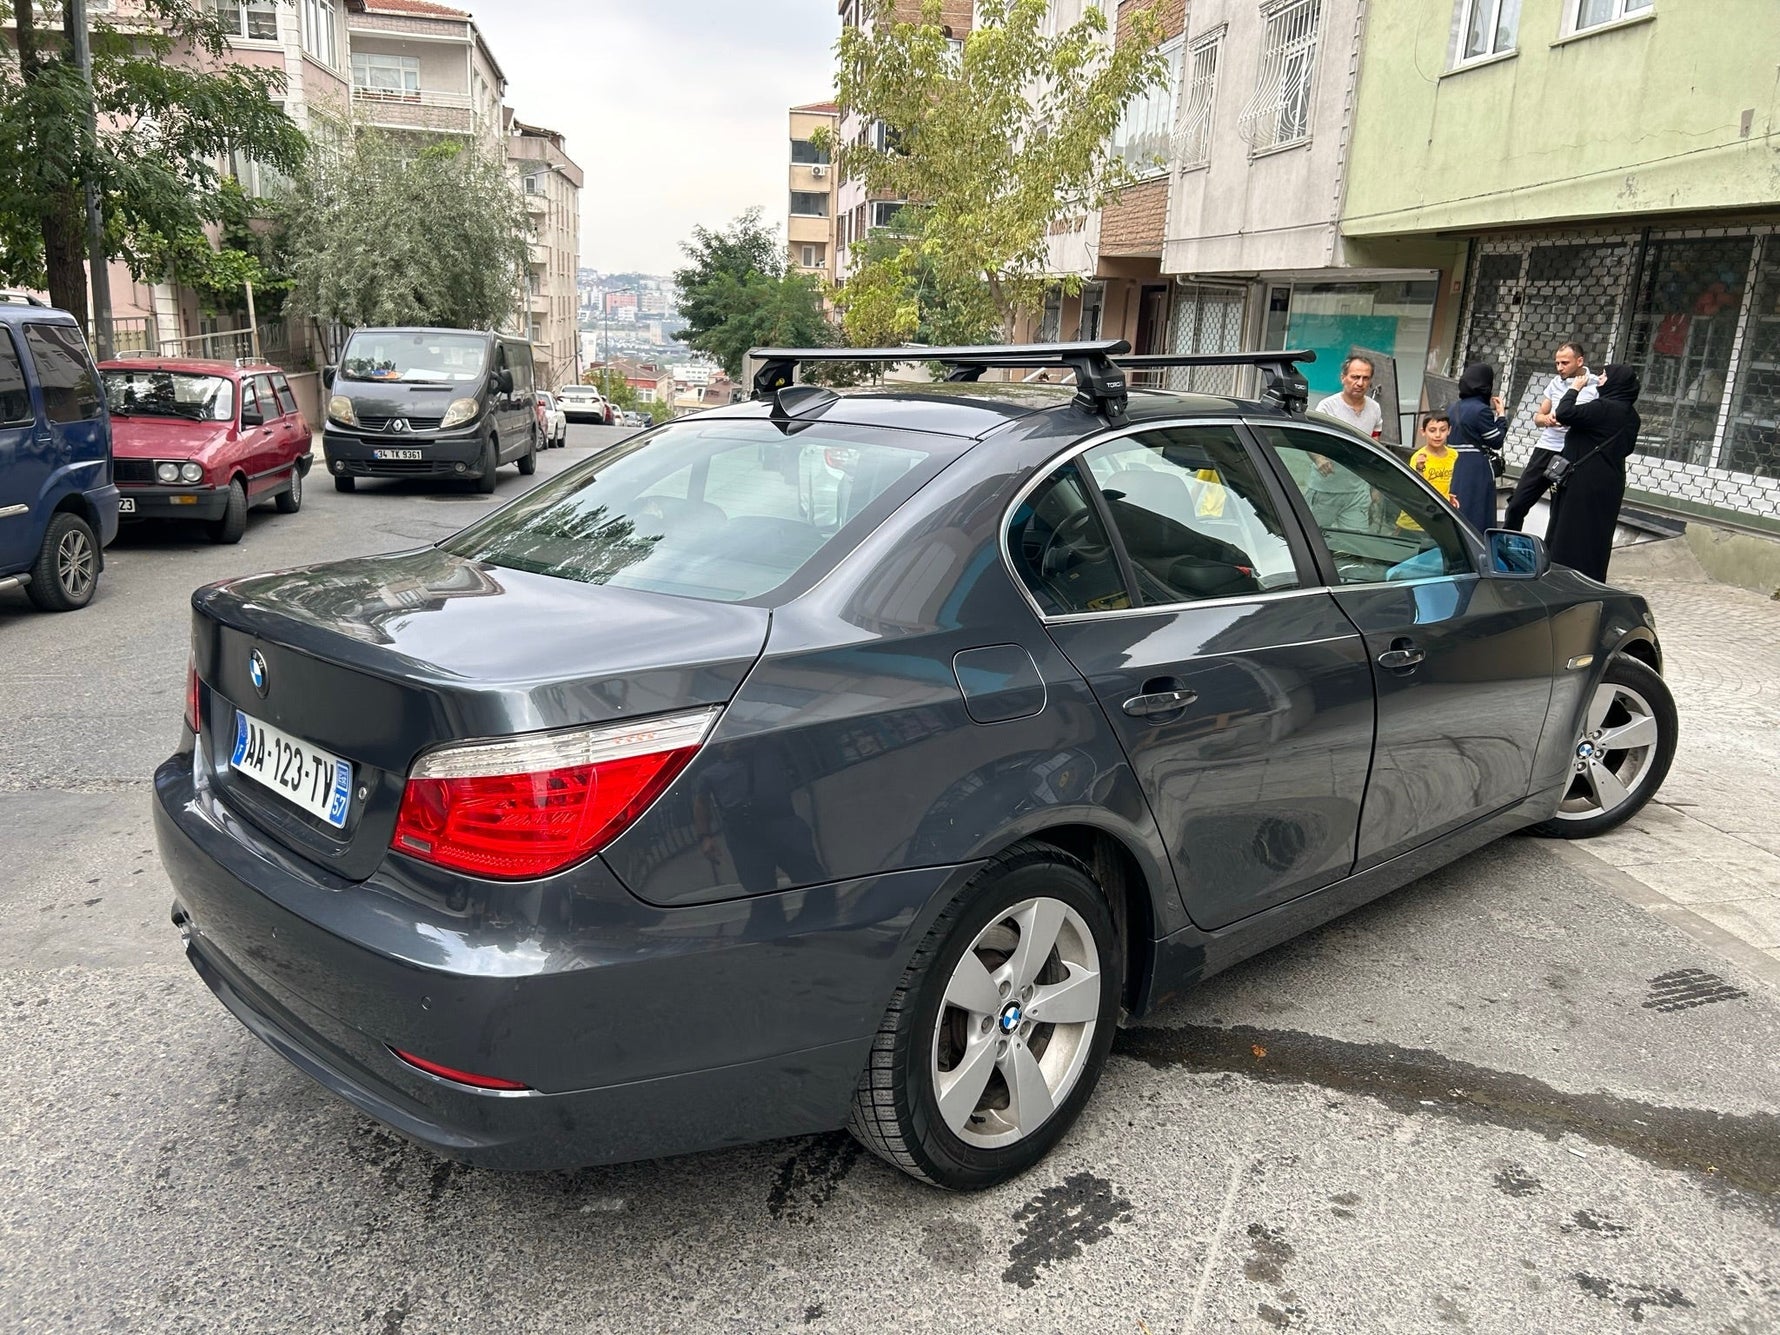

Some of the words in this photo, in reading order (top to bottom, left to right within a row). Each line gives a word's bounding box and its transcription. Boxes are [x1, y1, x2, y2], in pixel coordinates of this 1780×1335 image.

[378, 450, 388, 459] 34
[391, 450, 400, 459] TK
[402, 450, 420, 459] 9361
[244, 723, 335, 809] AA-123-TV
[332, 792, 347, 817] 57
